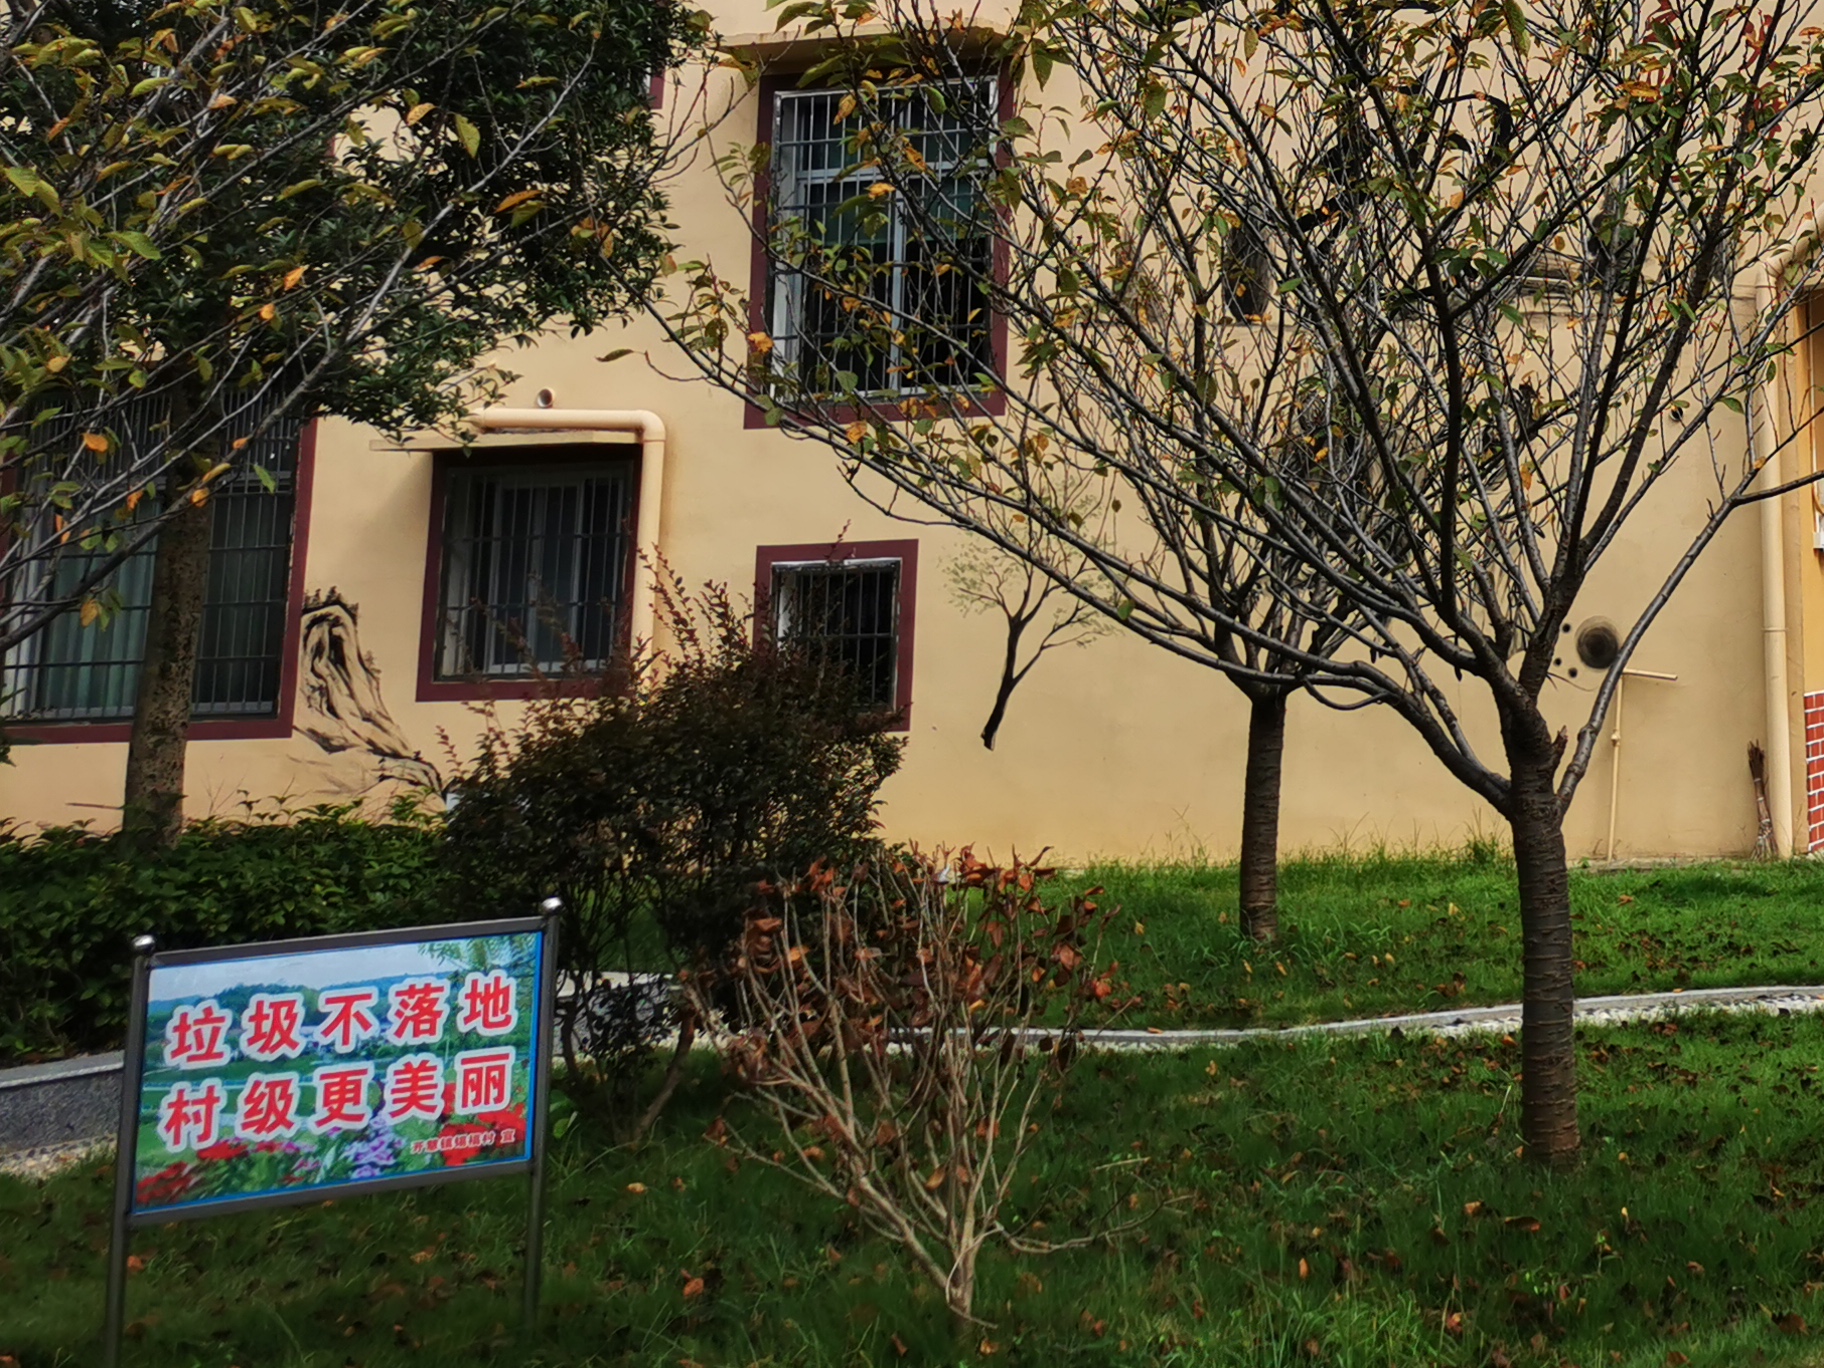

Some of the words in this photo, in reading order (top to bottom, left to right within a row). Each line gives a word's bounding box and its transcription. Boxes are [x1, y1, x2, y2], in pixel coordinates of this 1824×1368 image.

[169, 974, 513, 1063] 垃圾不落地
[163, 1052, 510, 1148] 村级更美丽
